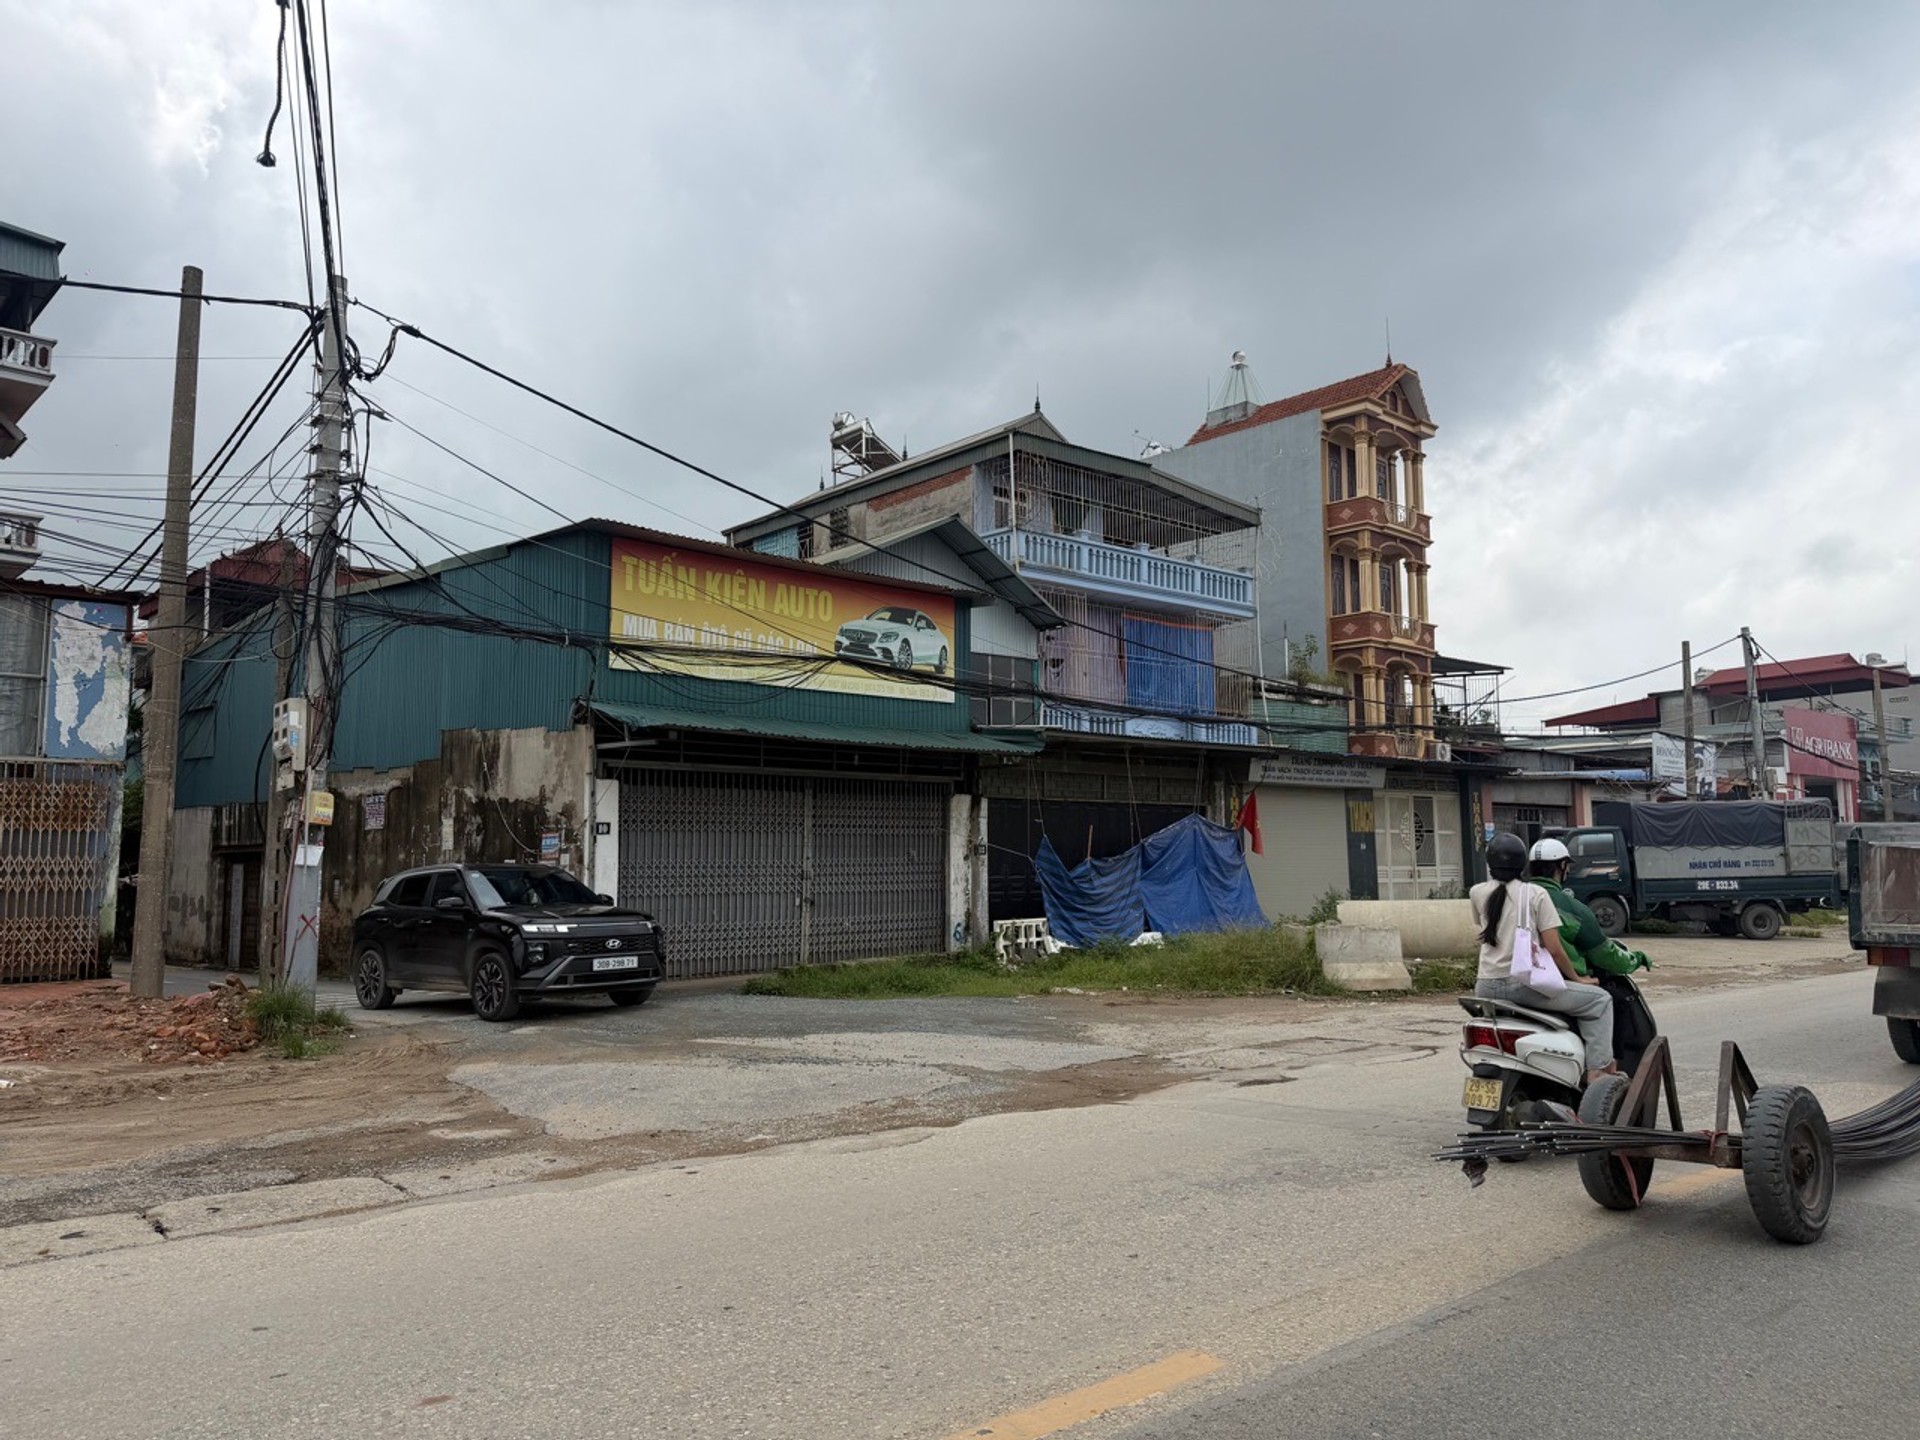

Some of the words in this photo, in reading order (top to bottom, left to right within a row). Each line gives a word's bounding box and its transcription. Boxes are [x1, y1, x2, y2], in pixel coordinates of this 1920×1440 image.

[621, 553, 696, 600] TUẤN
[704, 569, 766, 611] KIÊN
[772, 583, 834, 623] AUTO
[623, 614, 658, 640] MUA
[663, 617, 695, 644] BÁN
